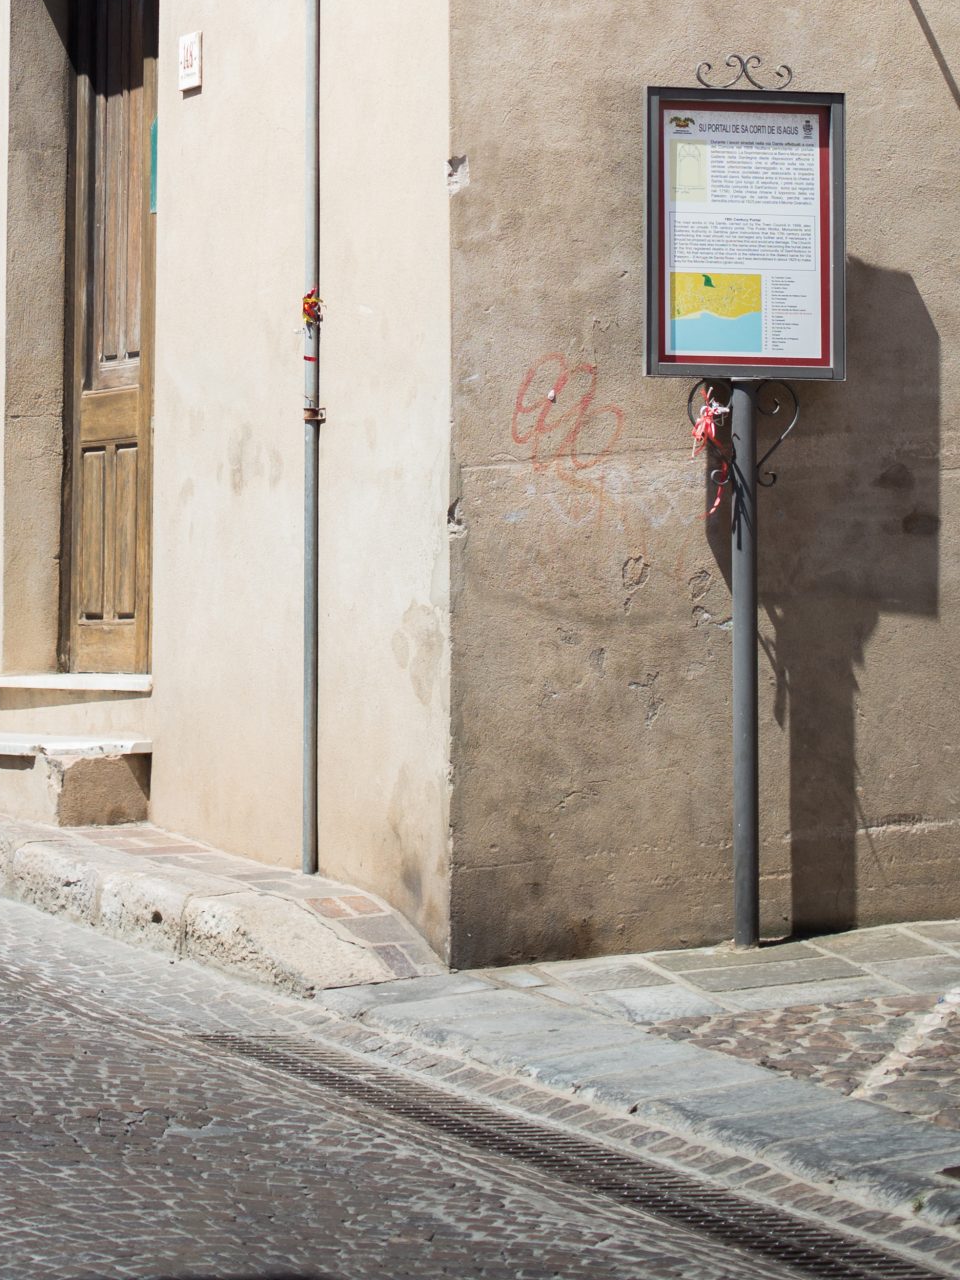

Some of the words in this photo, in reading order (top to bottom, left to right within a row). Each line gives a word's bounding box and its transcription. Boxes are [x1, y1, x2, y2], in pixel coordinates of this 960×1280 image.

[698, 123, 707, 133] SU
[708, 123, 732, 134] PORTALI
[732, 124, 740, 134] DE
[741, 125, 749, 134] SA
[749, 125, 767, 135] CORTI
[768, 125, 776, 135] DE
[777, 126, 783, 135] IS
[783, 126, 799, 136] AGUS
